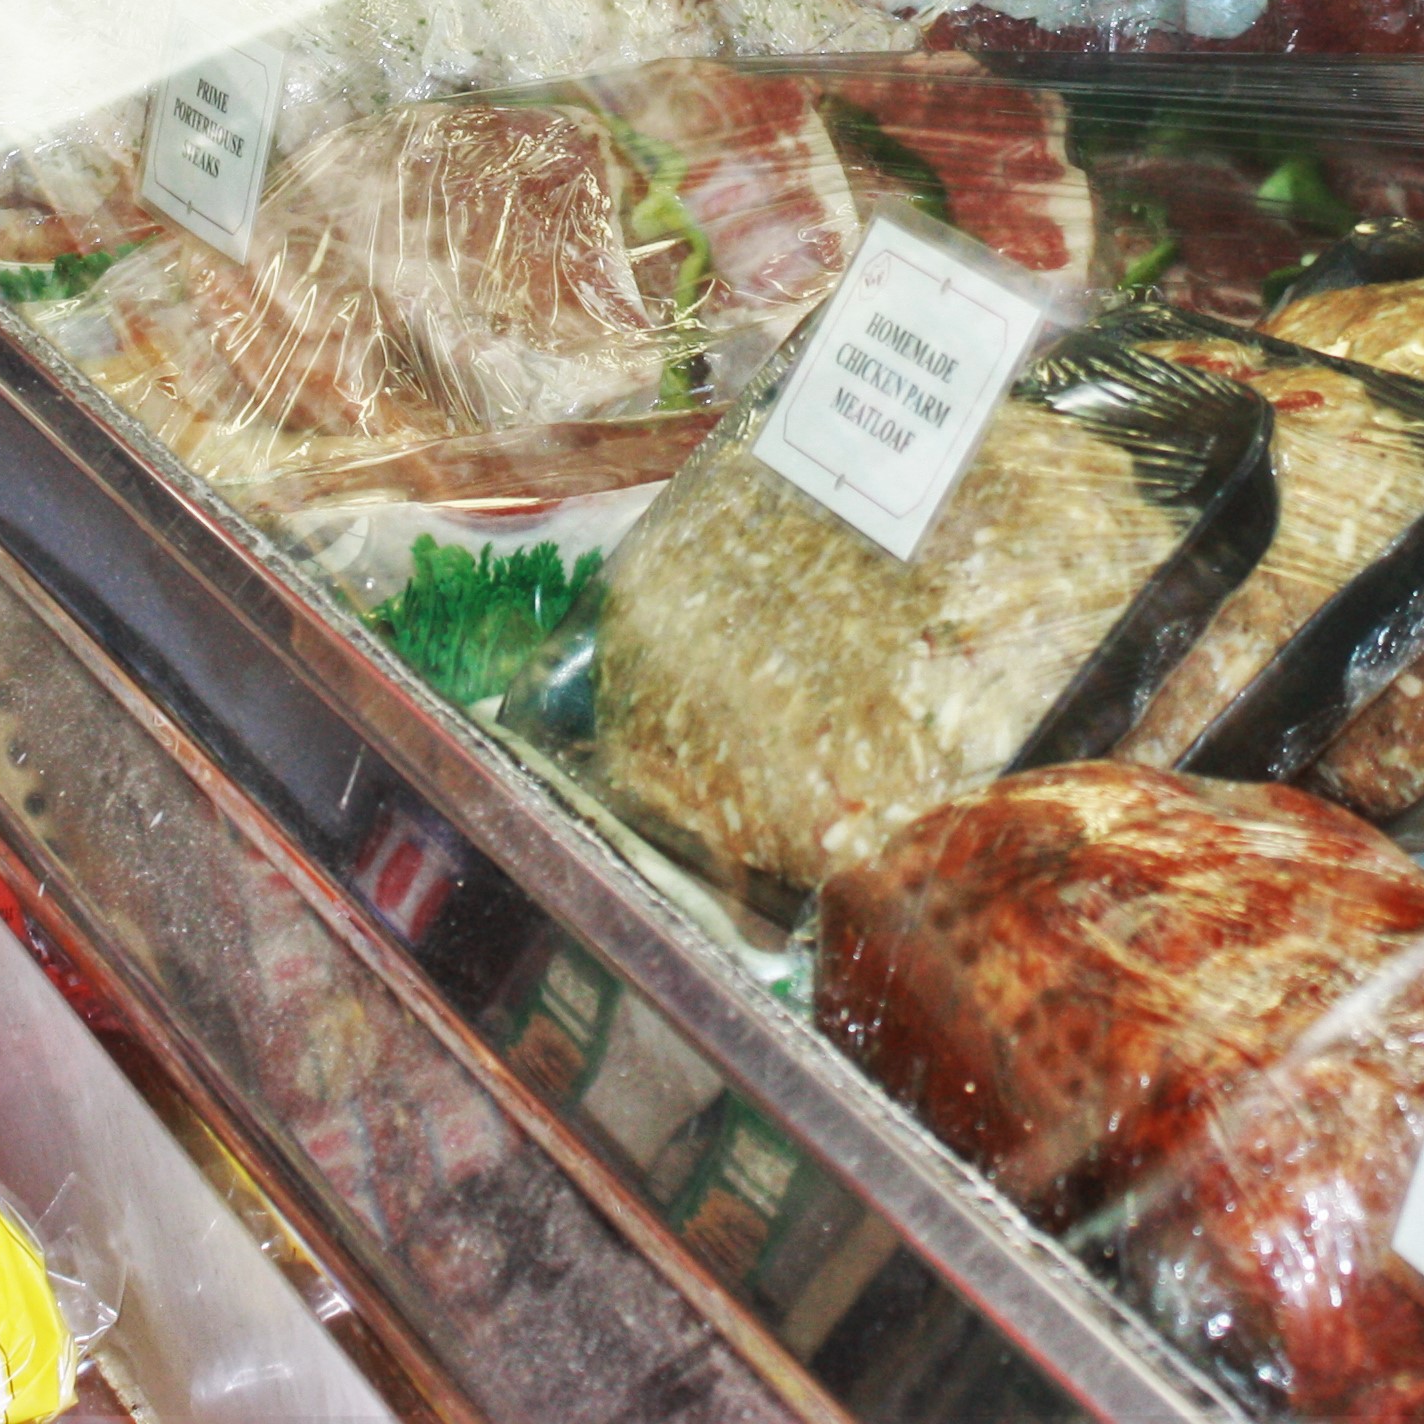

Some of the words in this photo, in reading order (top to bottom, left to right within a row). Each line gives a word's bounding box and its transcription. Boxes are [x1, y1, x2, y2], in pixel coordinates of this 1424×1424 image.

[173, 97, 245, 158] PORTERHOUSE
[196, 78, 230, 114] PRIME
[181, 138, 221, 178] STEAKS
[865, 312, 959, 384] HOMEMADE
[836, 342, 905, 402] CHICKEN
[902, 385, 952, 429] PARM
[829, 387, 916, 455] MEATLOAF
